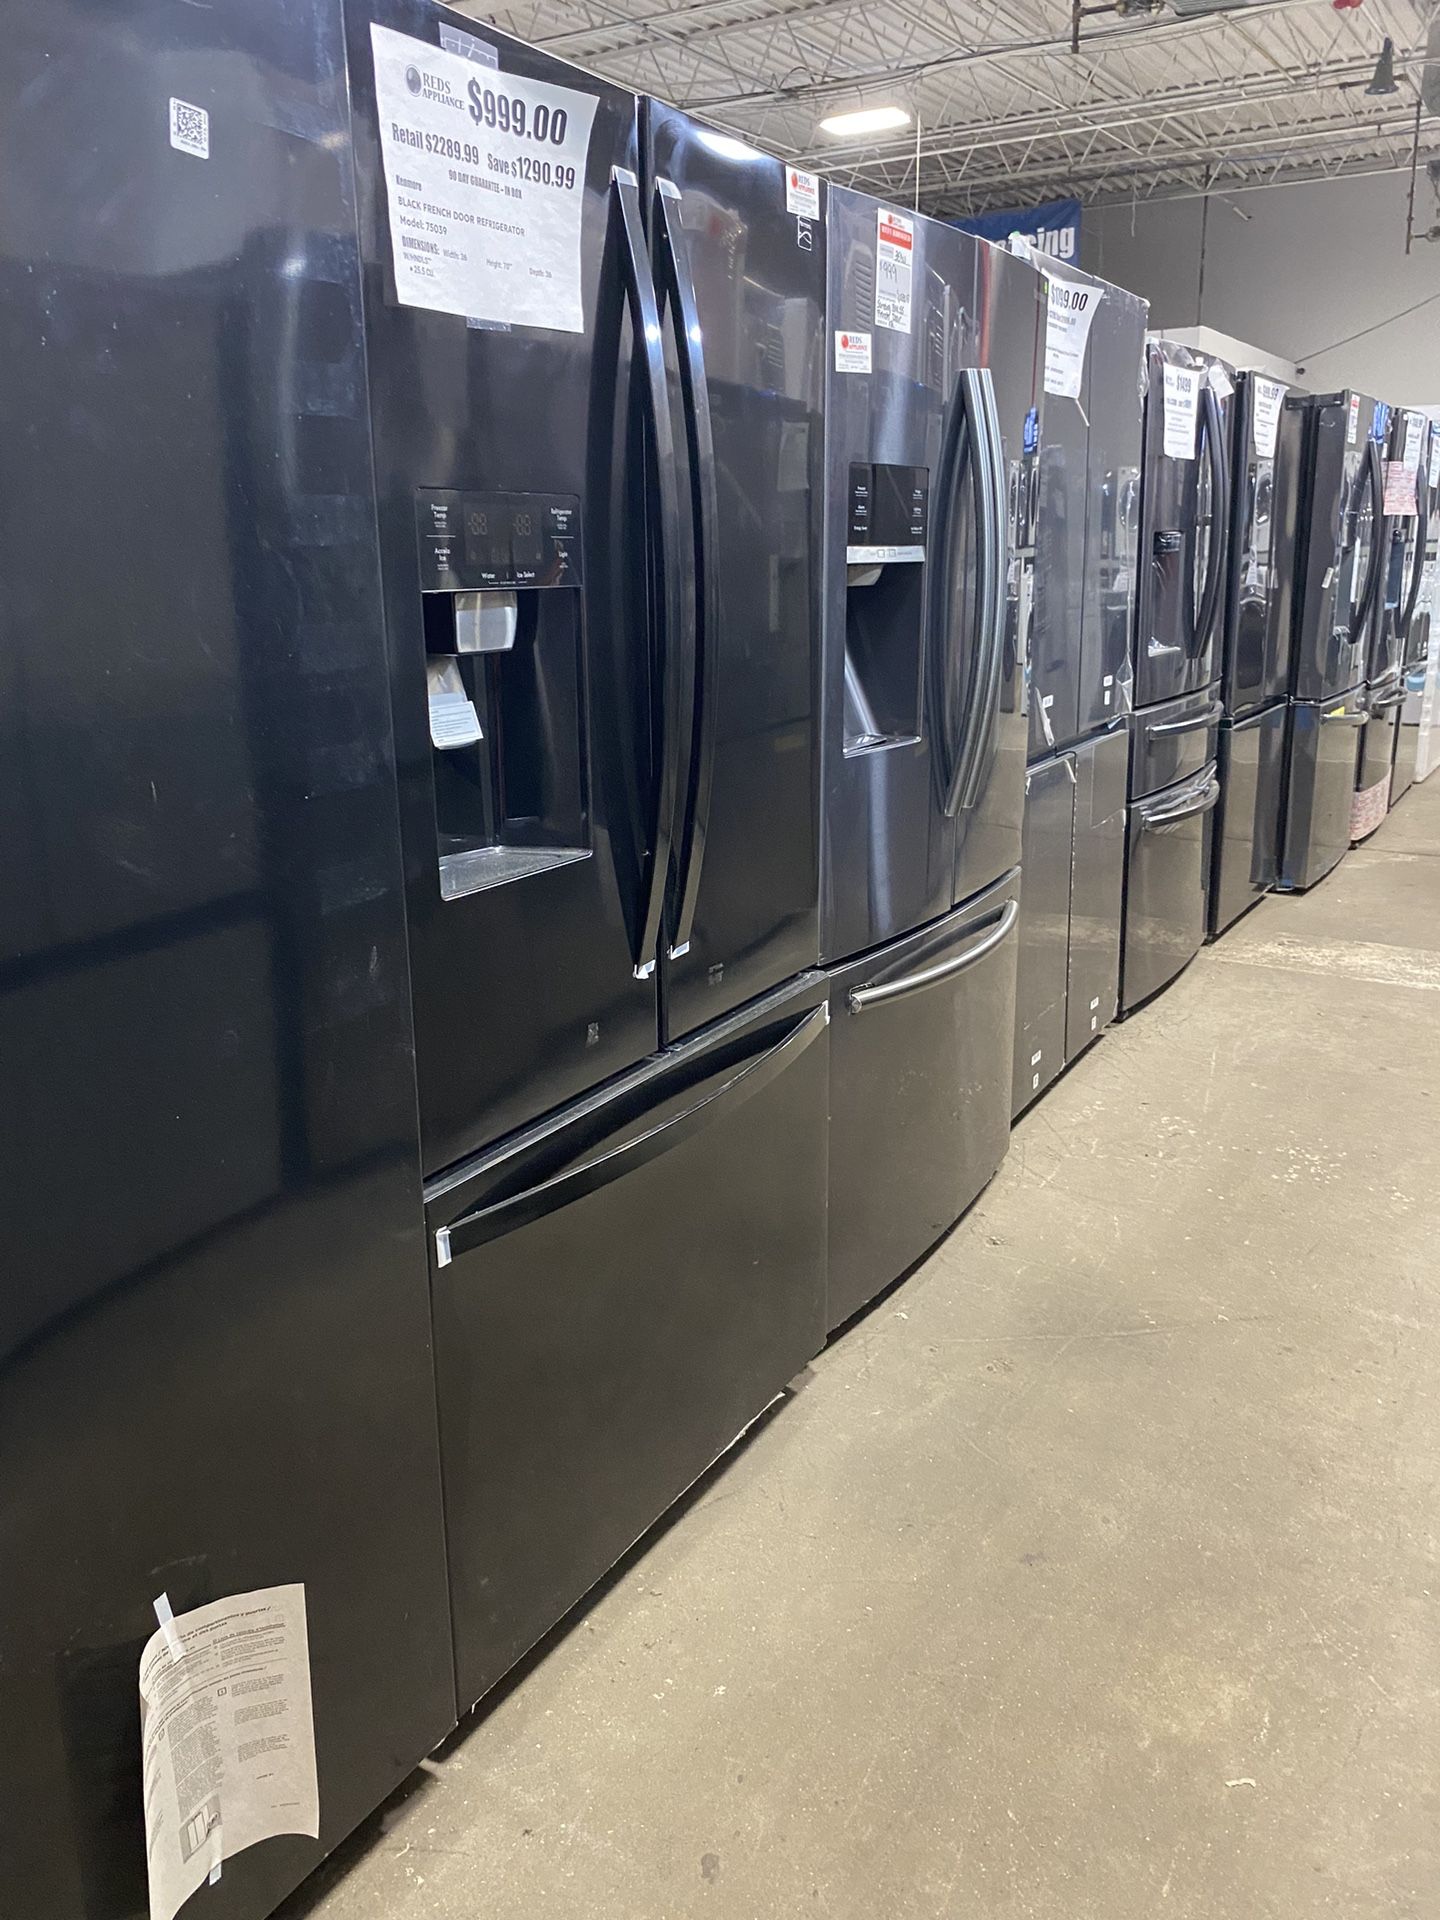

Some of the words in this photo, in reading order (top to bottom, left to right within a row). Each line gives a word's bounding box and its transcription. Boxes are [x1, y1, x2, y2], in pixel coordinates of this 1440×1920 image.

[422, 72, 450, 94] REDS
[422, 89, 465, 111] APPLIANCE
[467, 77, 568, 145] $999.00
[391, 122, 424, 150] Retail
[425, 133, 480, 165] $2289.99
[487, 153, 510, 174] Save
[510, 155, 576, 190] $1290.99
[398, 195, 422, 212] BLACK
[423, 203, 451, 219] FRENCH
[453, 210, 475, 224] DOOR
[476, 216, 525, 237] REFRIGERATOR
[425, 221, 448, 235] 75039
